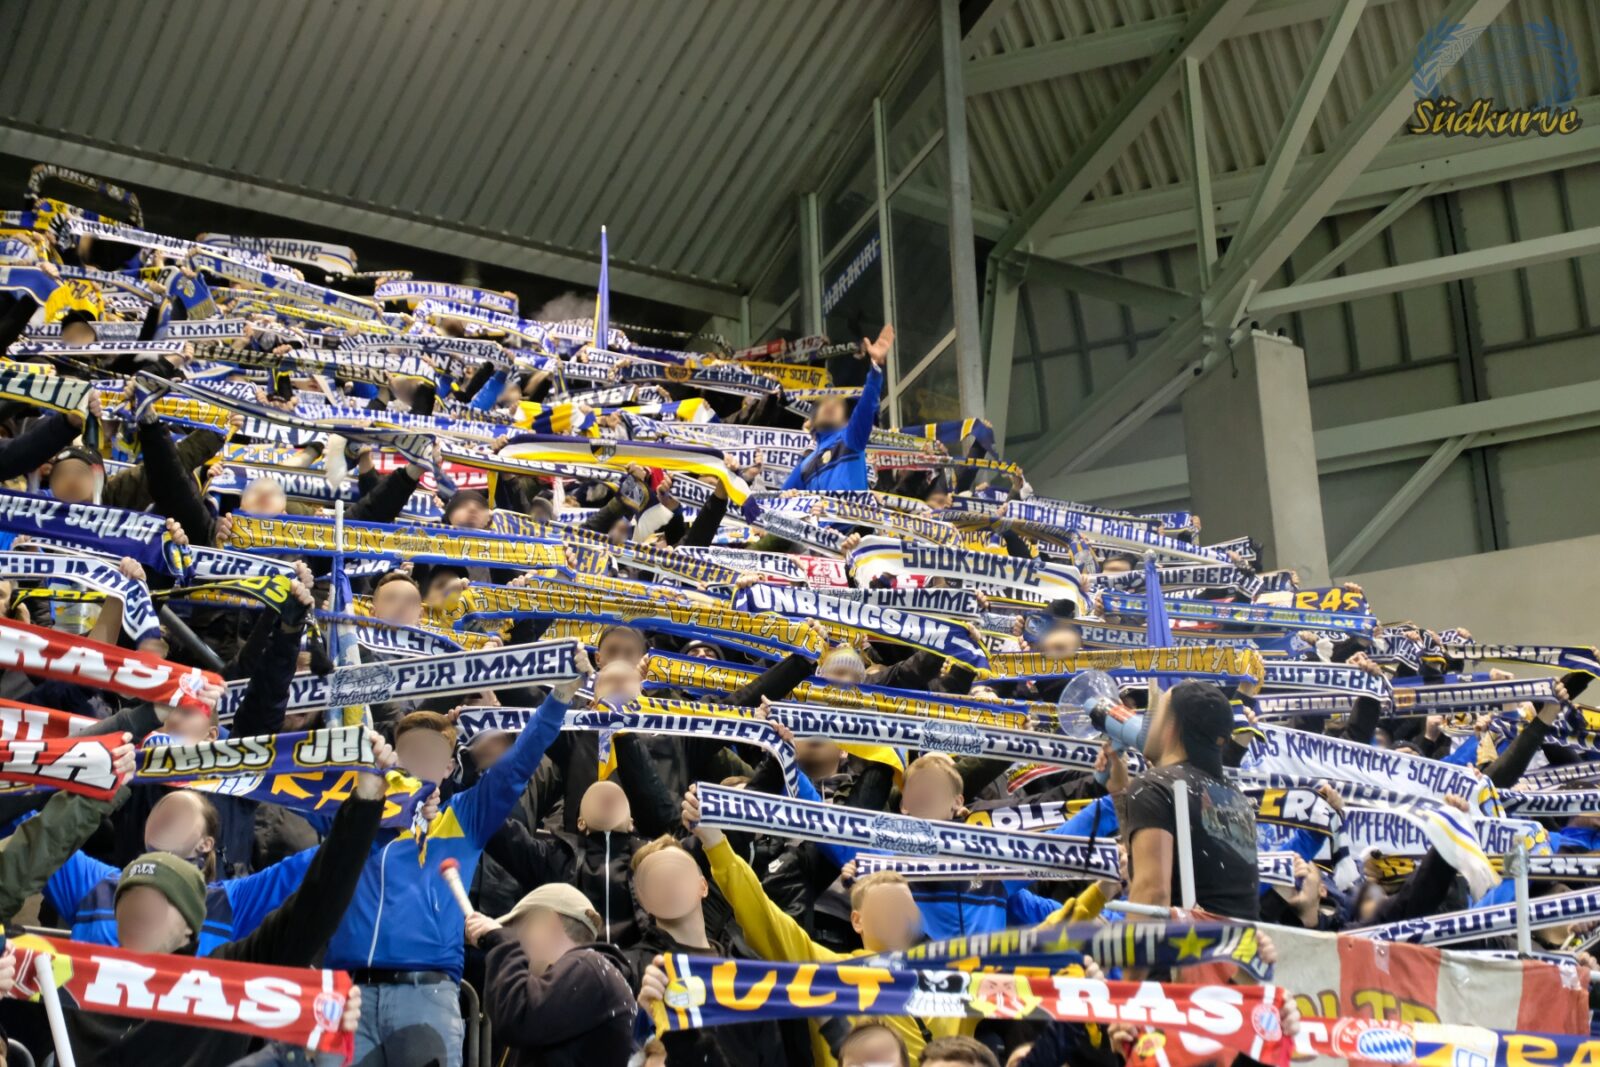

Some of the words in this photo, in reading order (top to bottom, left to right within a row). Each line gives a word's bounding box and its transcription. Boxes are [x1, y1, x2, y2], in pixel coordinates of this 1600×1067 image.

[221, 261, 267, 288] CARL
[272, 276, 325, 303] ZEISS
[330, 294, 376, 320] JENA
[743, 429, 777, 446] FÜR
[804, 524, 839, 549] FÜR
[195, 551, 253, 575] FÜR
[752, 582, 950, 651] UNBEUGSAM
[1082, 626, 1103, 642] FC
[396, 661, 456, 691] FÜR
[463, 647, 578, 684] IMMER
[771, 706, 921, 741] SÜDKURVE
[1250, 729, 1280, 761] DAS
[1285, 731, 1401, 780] KÄMPFERHERZ
[1407, 760, 1478, 801] SCHLÄGT
[696, 790, 872, 840] SÜDKURVE
[939, 830, 1005, 858] FÜR
[1008, 839, 1121, 873] IMMER
[84, 956, 302, 1029] RAS
[712, 960, 895, 1011] ULT
[1053, 977, 1245, 1036] RAS
